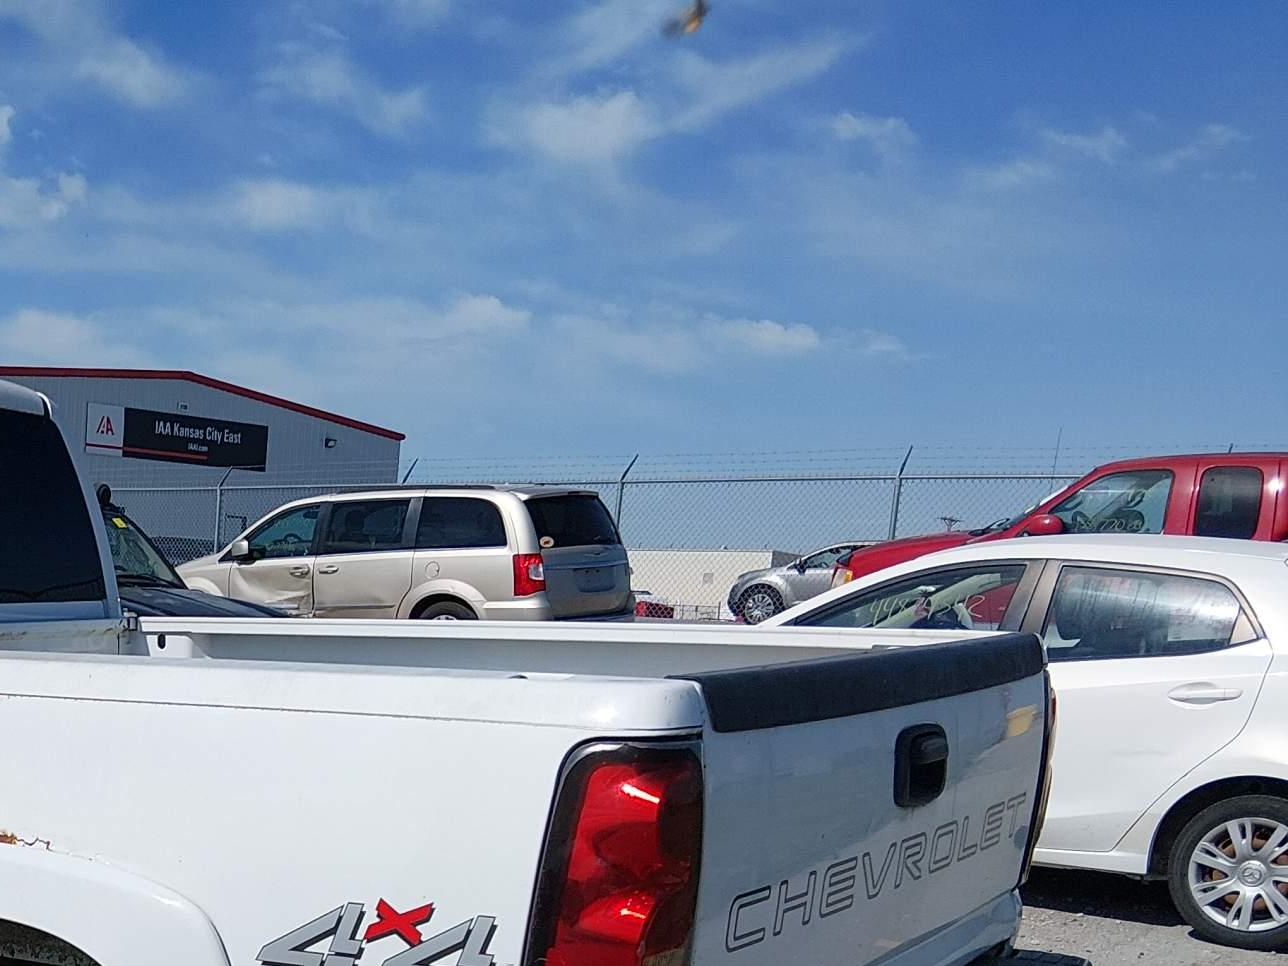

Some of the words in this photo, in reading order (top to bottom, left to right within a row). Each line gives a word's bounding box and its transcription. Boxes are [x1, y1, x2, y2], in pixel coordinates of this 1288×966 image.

[155, 420, 171, 436] IAA
[173, 423, 204, 440] Kansas
[206, 426, 222, 445] City
[224, 429, 241, 444] East
[725, 792, 1026, 953] CHEVROLET
